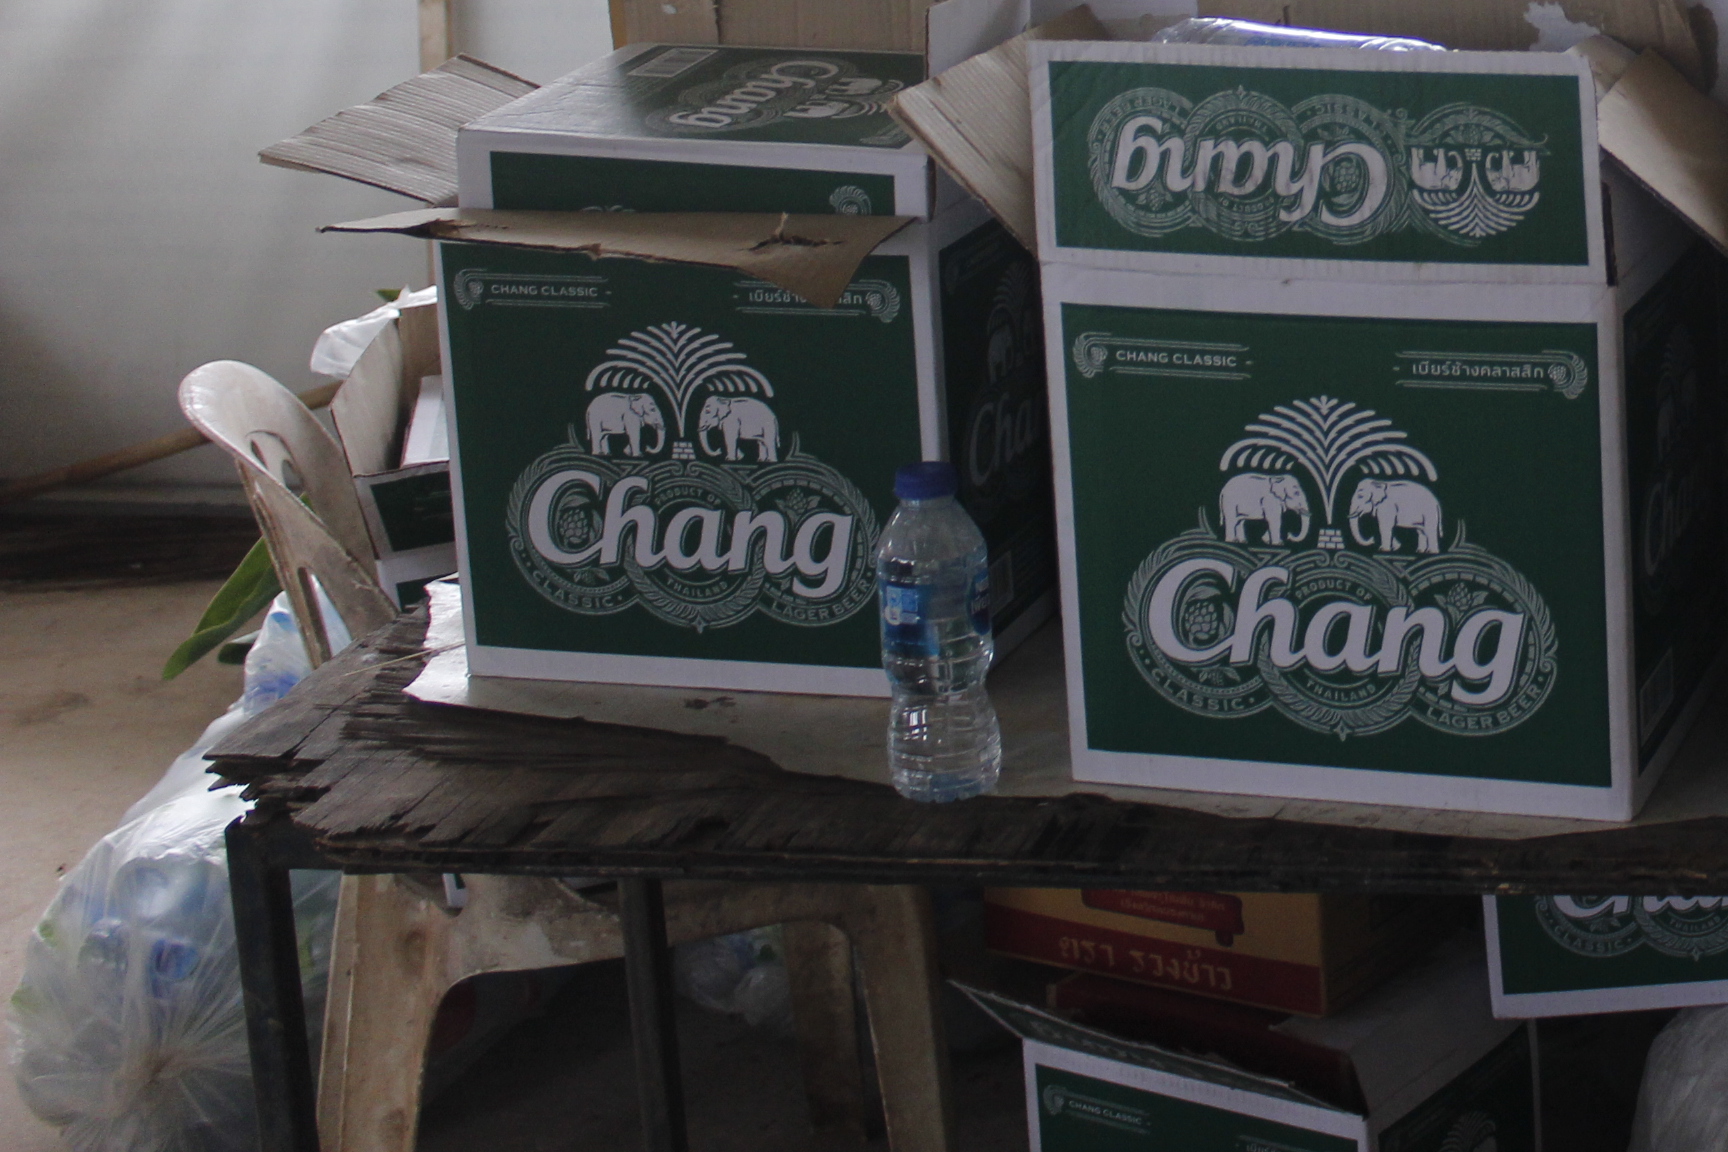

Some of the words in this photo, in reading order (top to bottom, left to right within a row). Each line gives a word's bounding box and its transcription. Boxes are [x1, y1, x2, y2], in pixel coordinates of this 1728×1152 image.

[1112, 115, 1389, 227] Chang
[490, 281, 539, 296] CHANG
[541, 284, 599, 298] CLASSIC
[1115, 351, 1168, 365] CHANG
[1171, 353, 1238, 368] CLASSIC
[1411, 360, 1545, 380] เบียร์ช้างคลาสสิก
[527, 469, 855, 599] Chang
[532, 570, 613, 609] CLASSIC
[666, 578, 730, 597] THAILAND
[772, 601, 831, 621] LAGER
[832, 579, 873, 617] BEER
[1147, 557, 1525, 706] Chang
[1149, 669, 1244, 711] CLASSIC
[1305, 679, 1379, 703] THAILAND
[1425, 706, 1494, 730] LAGER
[1495, 683, 1542, 725] BEER
[1553, 926, 1623, 952] CLASSIC
[1127, 948, 1233, 991] รวงข้าว
[1068, 1099, 1101, 1115] CHANG
[1102, 1107, 1143, 1125] CLASSIC
